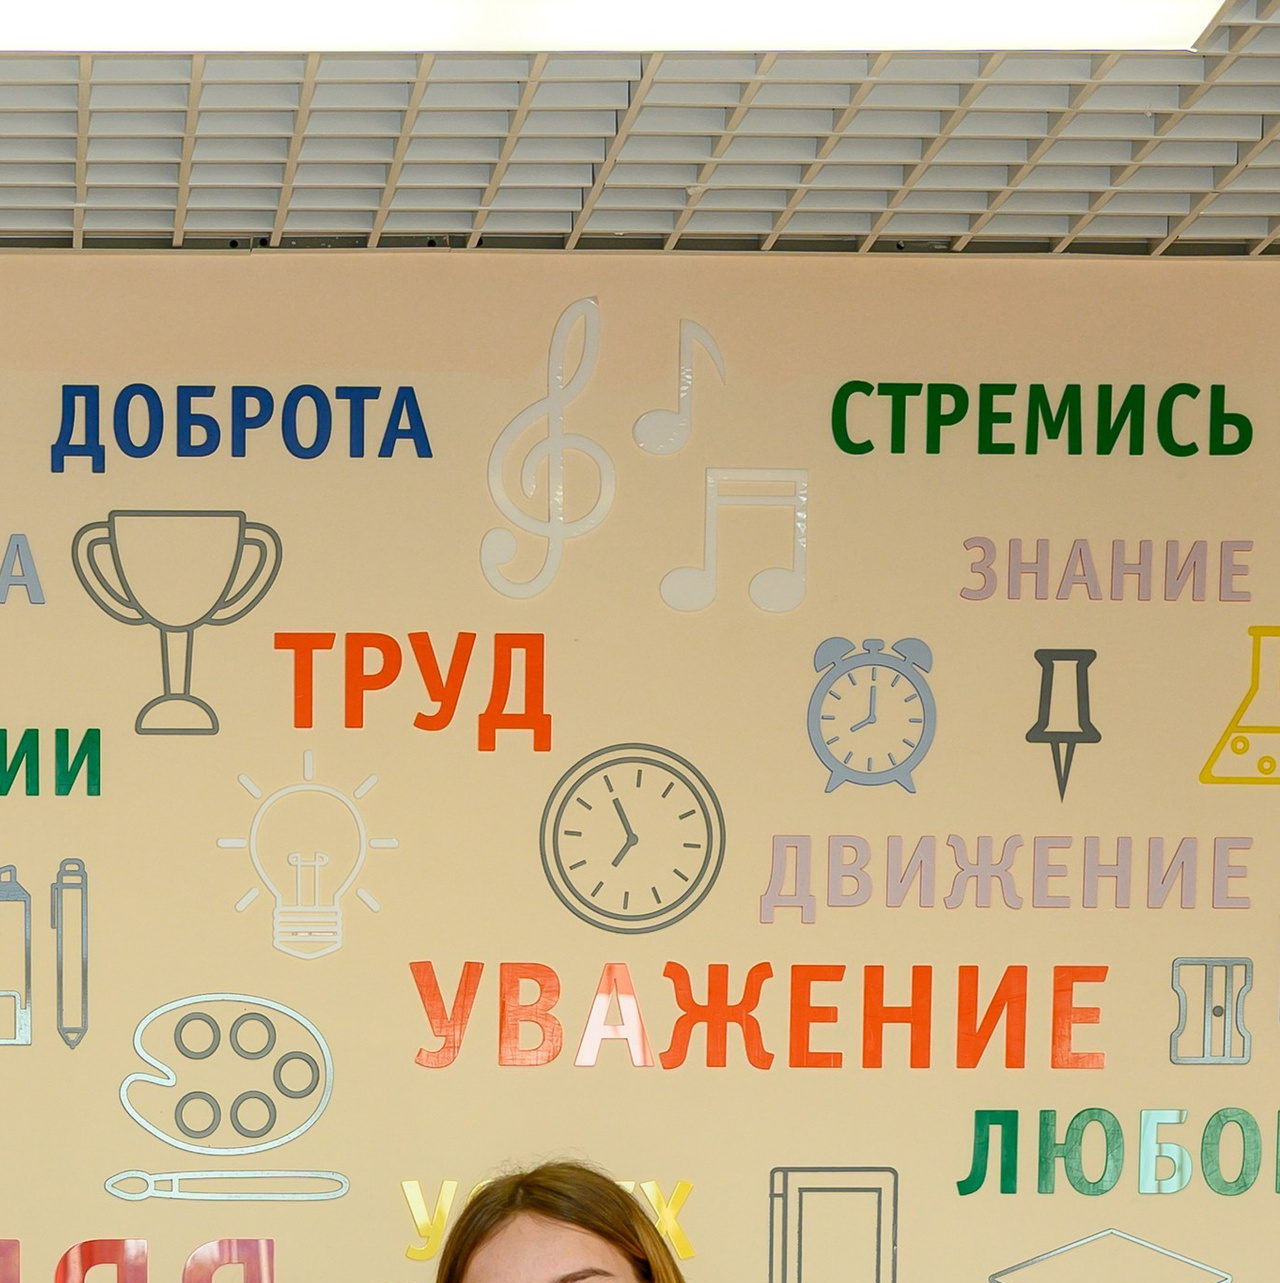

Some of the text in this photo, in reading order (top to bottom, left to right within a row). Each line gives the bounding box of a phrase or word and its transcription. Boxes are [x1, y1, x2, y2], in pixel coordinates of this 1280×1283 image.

[50, 382, 434, 475] ДОБРОТА
[831, 379, 1254, 458] СТРЕМИСЬ
[959, 536, 1254, 602] ЗНАНИЕ
[273, 630, 553, 753] ТРУД
[759, 834, 1254, 925] ДВИЖЕНИЕ
[408, 959, 1109, 1071] УВАЖЕНИЕ
[955, 1107, 1280, 1197] ЛЮБО
